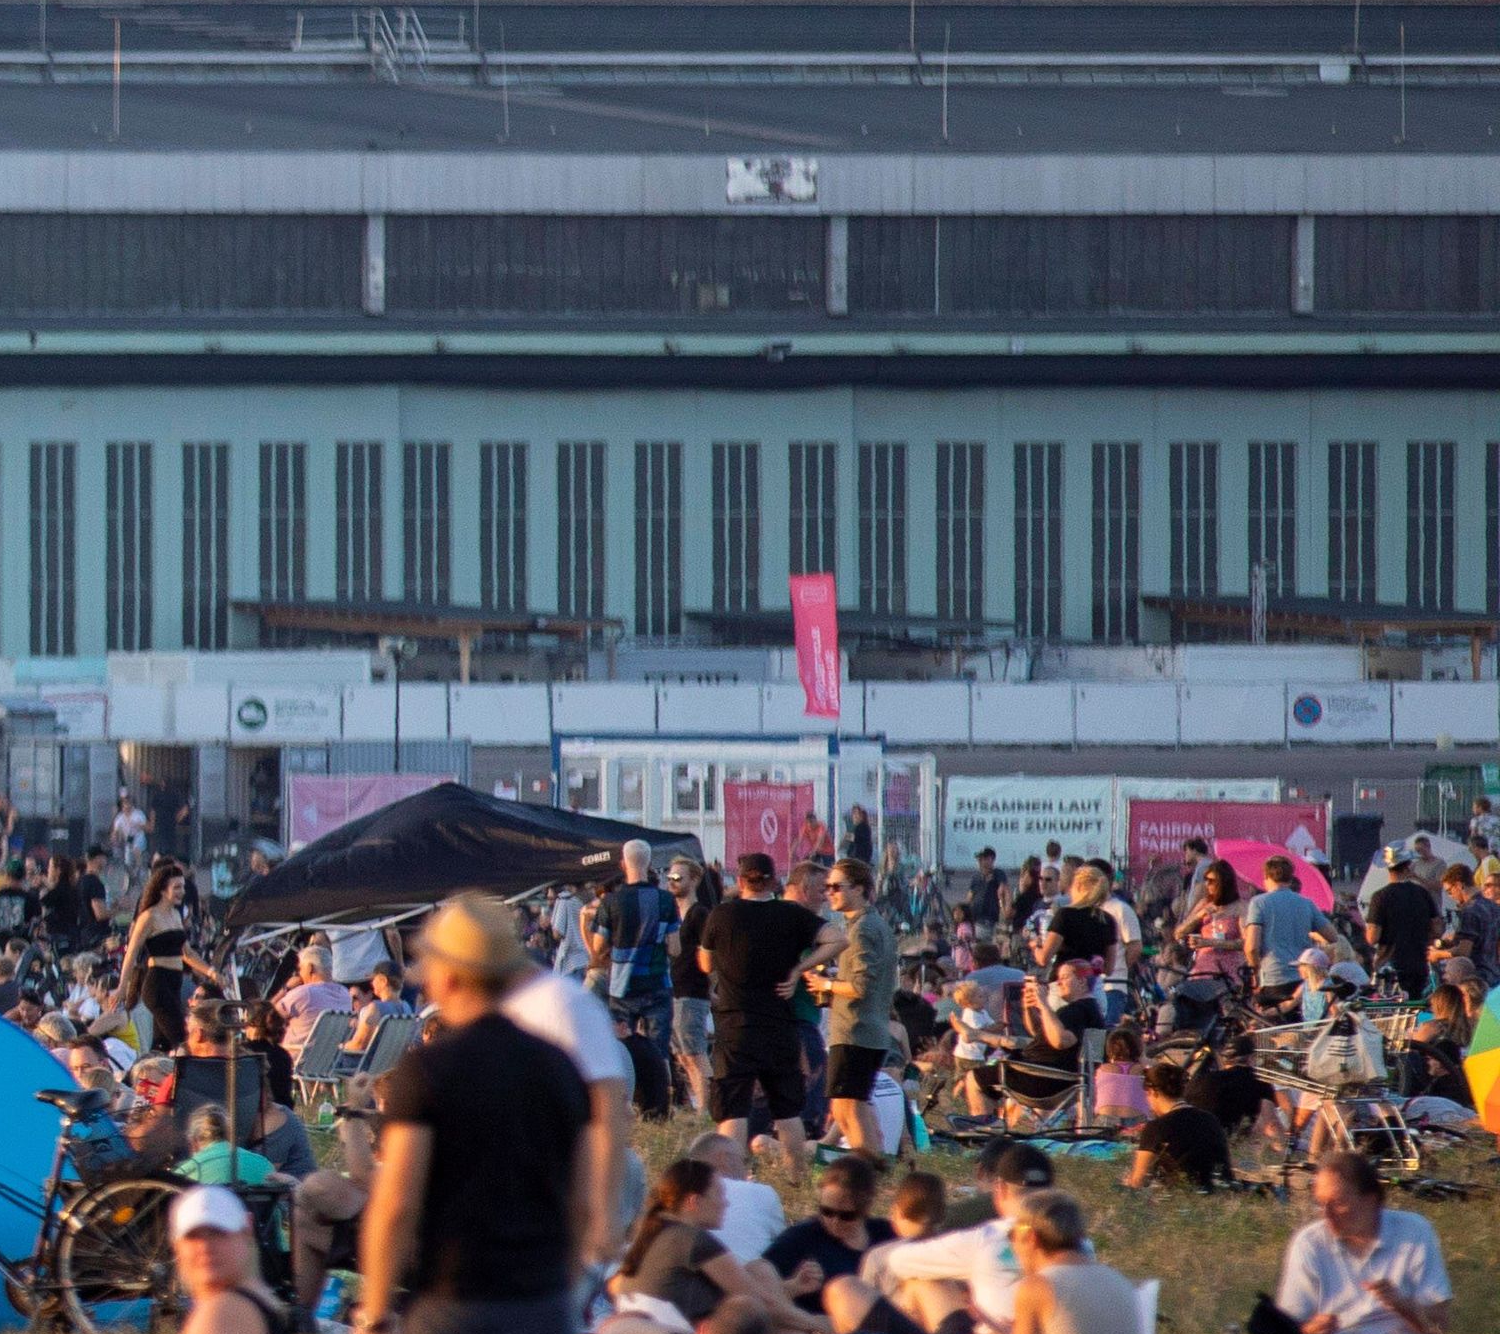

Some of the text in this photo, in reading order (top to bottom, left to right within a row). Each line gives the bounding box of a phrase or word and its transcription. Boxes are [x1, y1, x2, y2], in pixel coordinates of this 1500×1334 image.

[956, 797, 1102, 813] ZUSAMMEN LAUT
[953, 814, 1105, 834] FÜR DIE ZUKUNFT
[1139, 820, 1215, 837] FAHRRAD
